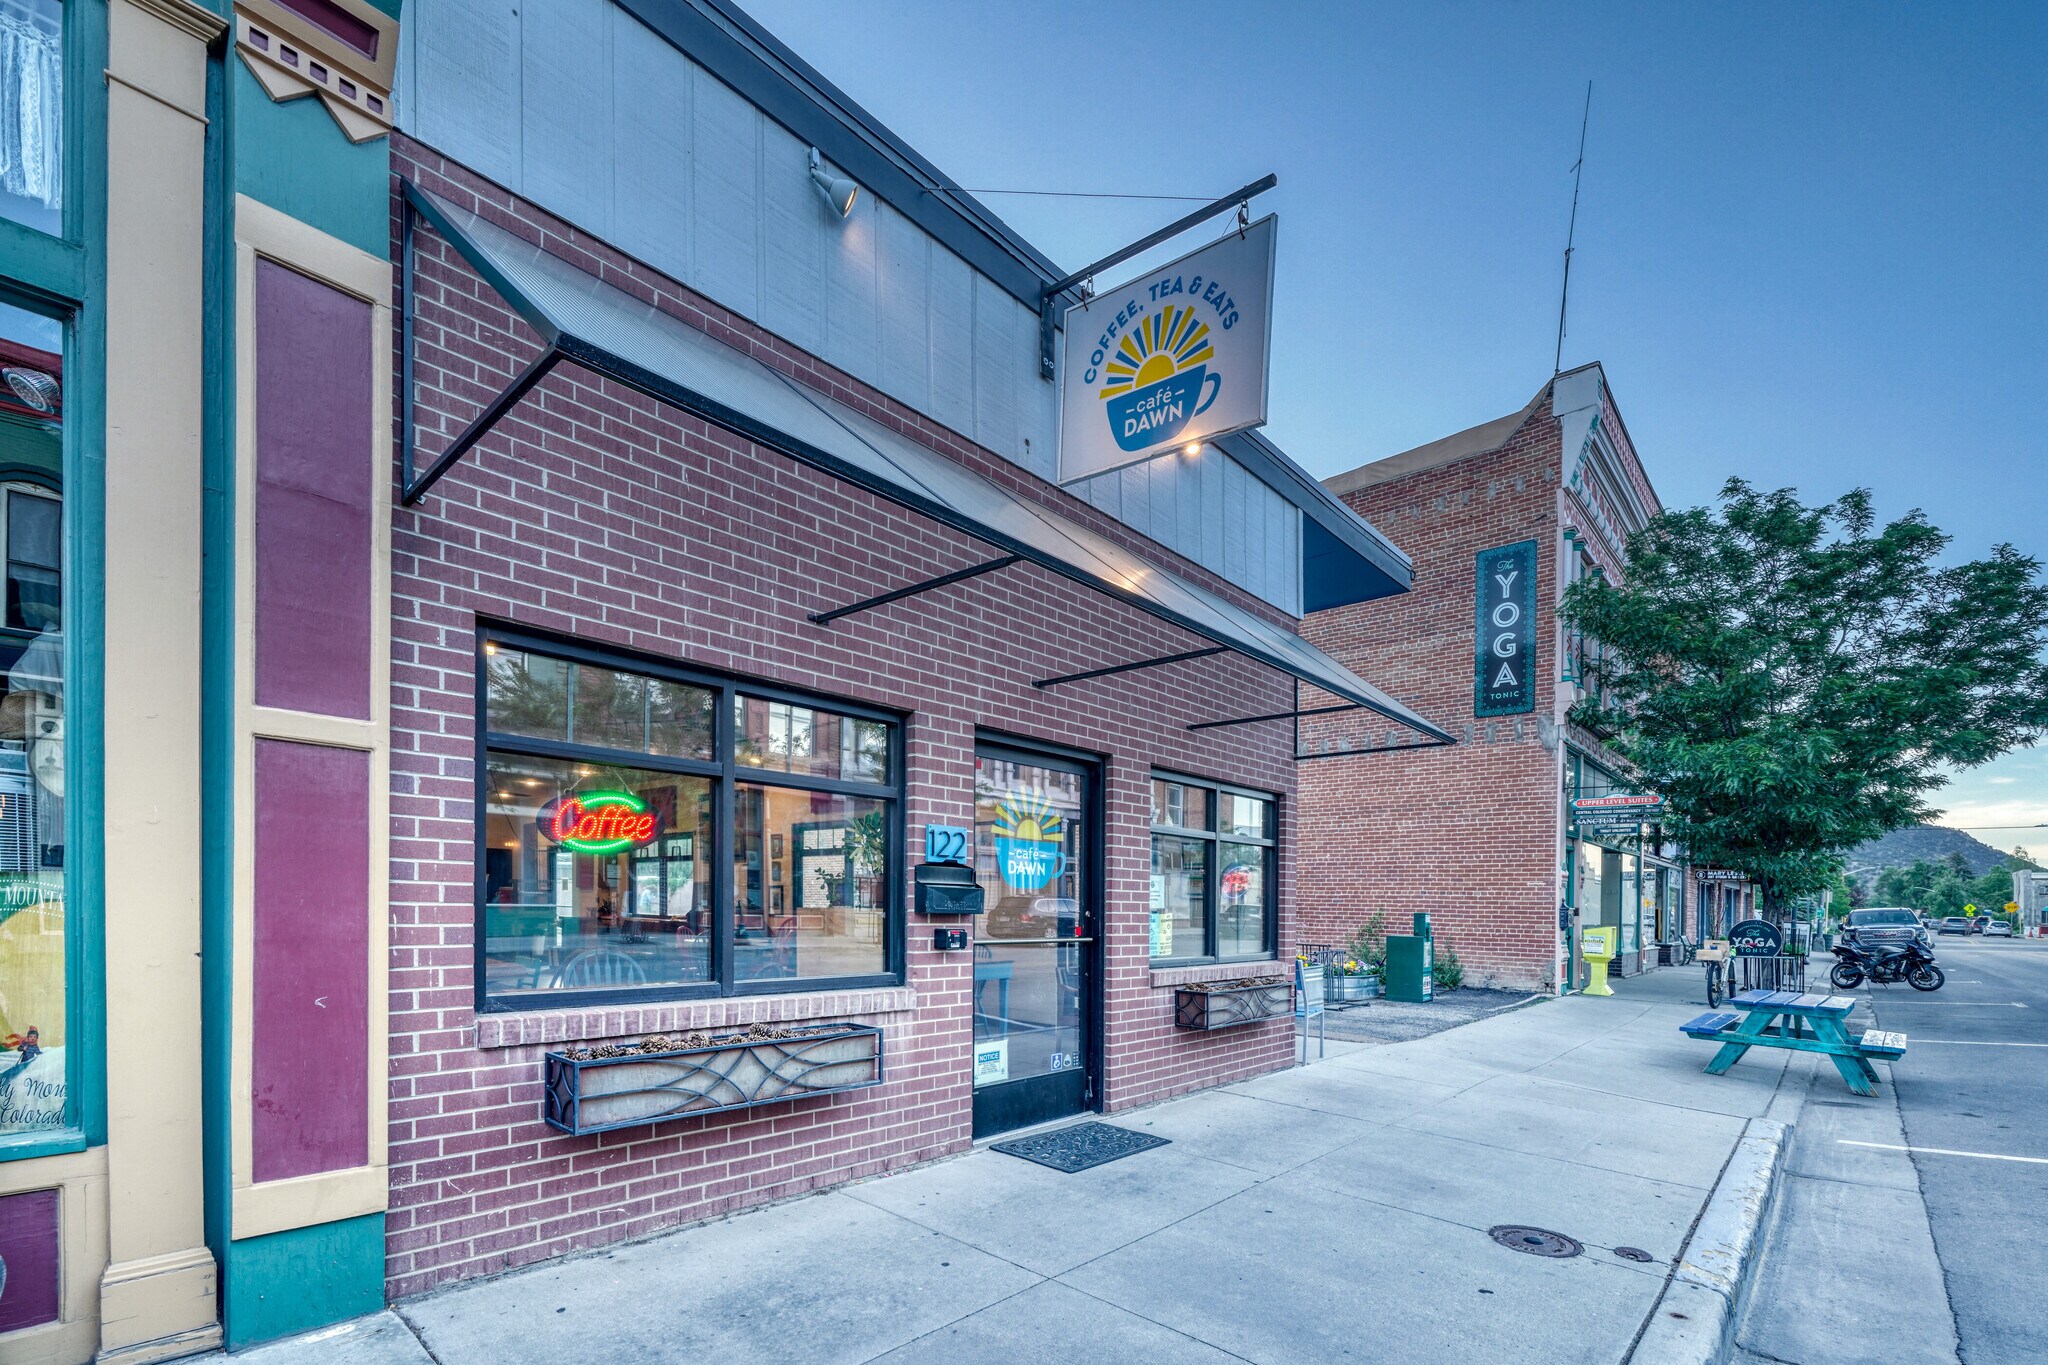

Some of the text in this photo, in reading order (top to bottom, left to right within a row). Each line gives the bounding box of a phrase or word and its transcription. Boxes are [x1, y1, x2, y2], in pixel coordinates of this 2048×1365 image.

[1084, 276, 1239, 385] COFFEE, TEA & EATS
[1137, 386, 1172, 413] café
[1124, 401, 1183, 438] DAWN
[1497, 559, 1514, 572] The
[1492, 571, 1520, 688] YOGA
[1490, 691, 1519, 700] TONIC
[1628, 796, 1653, 804] SUITES
[555, 797, 653, 839] Coffee
[929, 829, 966, 859] 122
[1016, 847, 1039, 860] café
[1008, 860, 1046, 876] DAWN
[1732, 937, 1776, 948] YOGA
[979, 1052, 999, 1061] NOTICE
